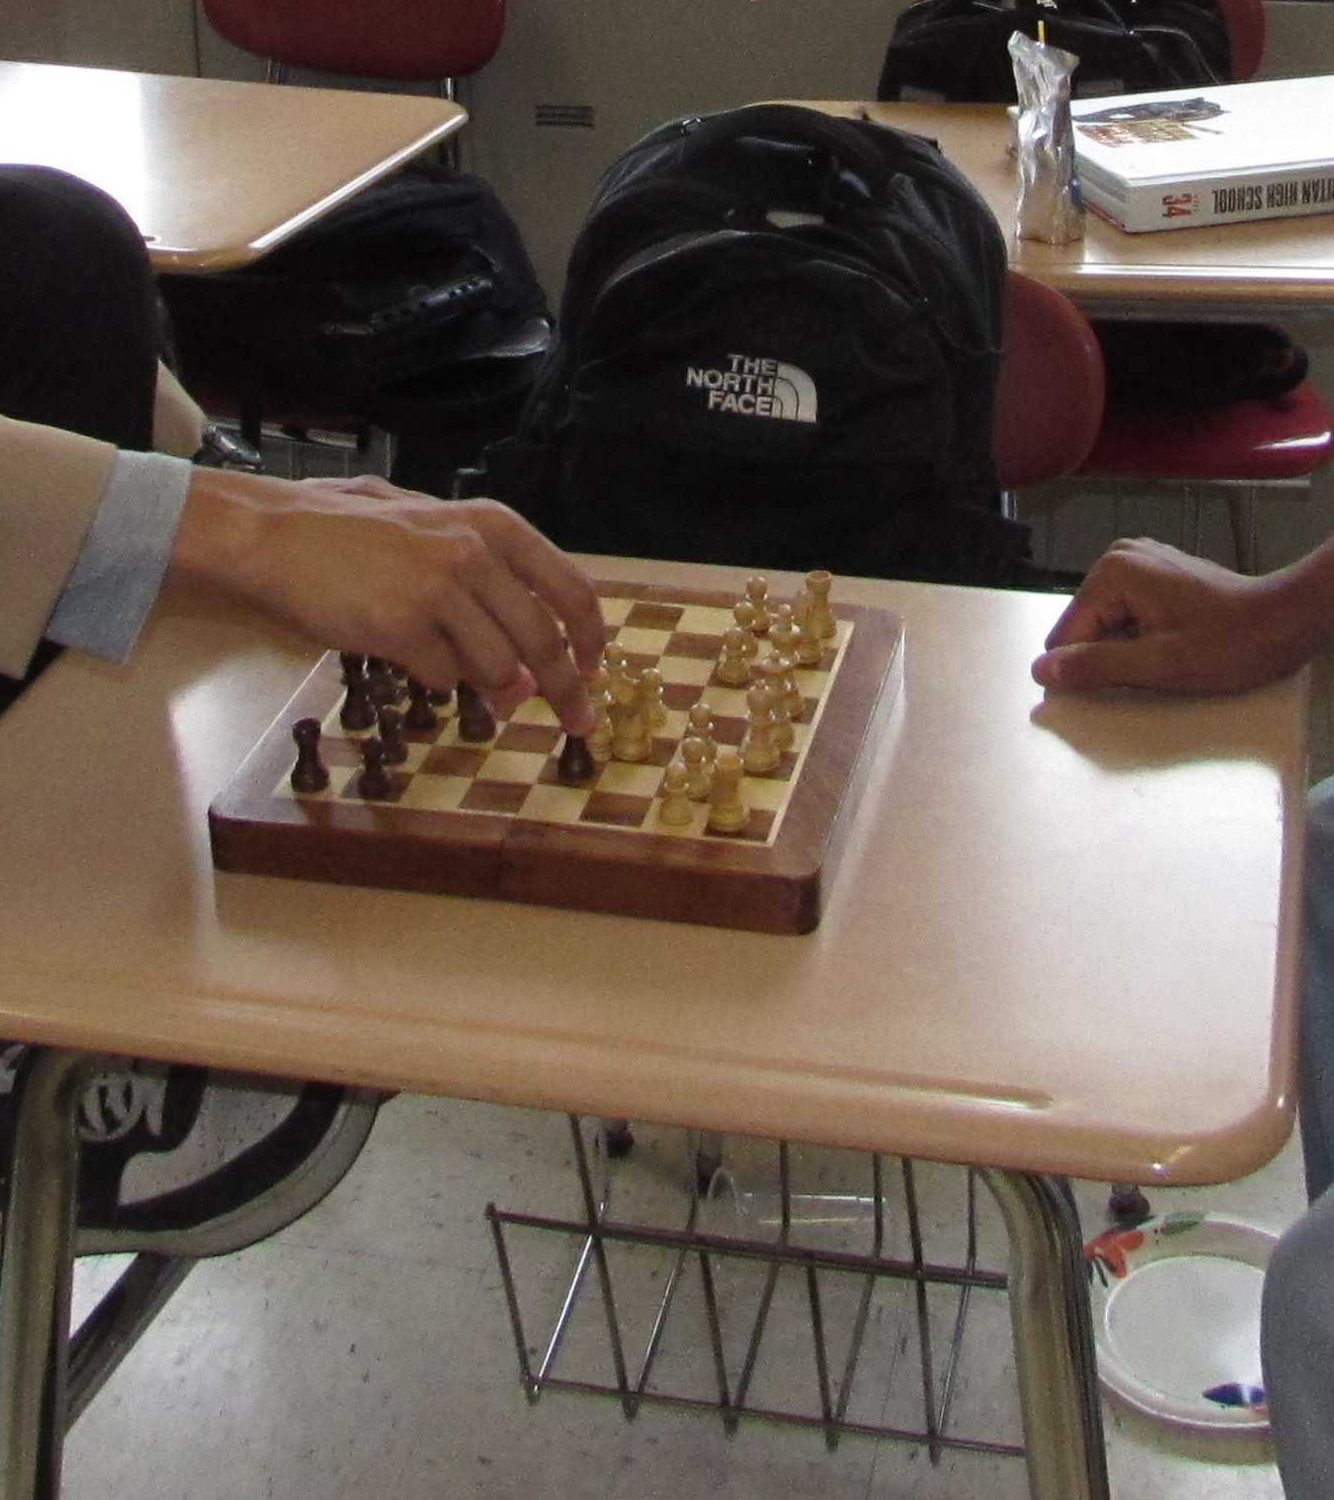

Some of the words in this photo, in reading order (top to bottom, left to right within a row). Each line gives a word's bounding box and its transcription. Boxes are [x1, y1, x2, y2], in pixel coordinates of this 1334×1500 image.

[1161, 192, 1192, 218] 34
[1212, 185, 1263, 215] SCHOOL
[1267, 180, 1298, 209] HIGH
[728, 354, 777, 375] THE
[686, 367, 774, 395] NORTH
[708, 391, 773, 416] FACE
